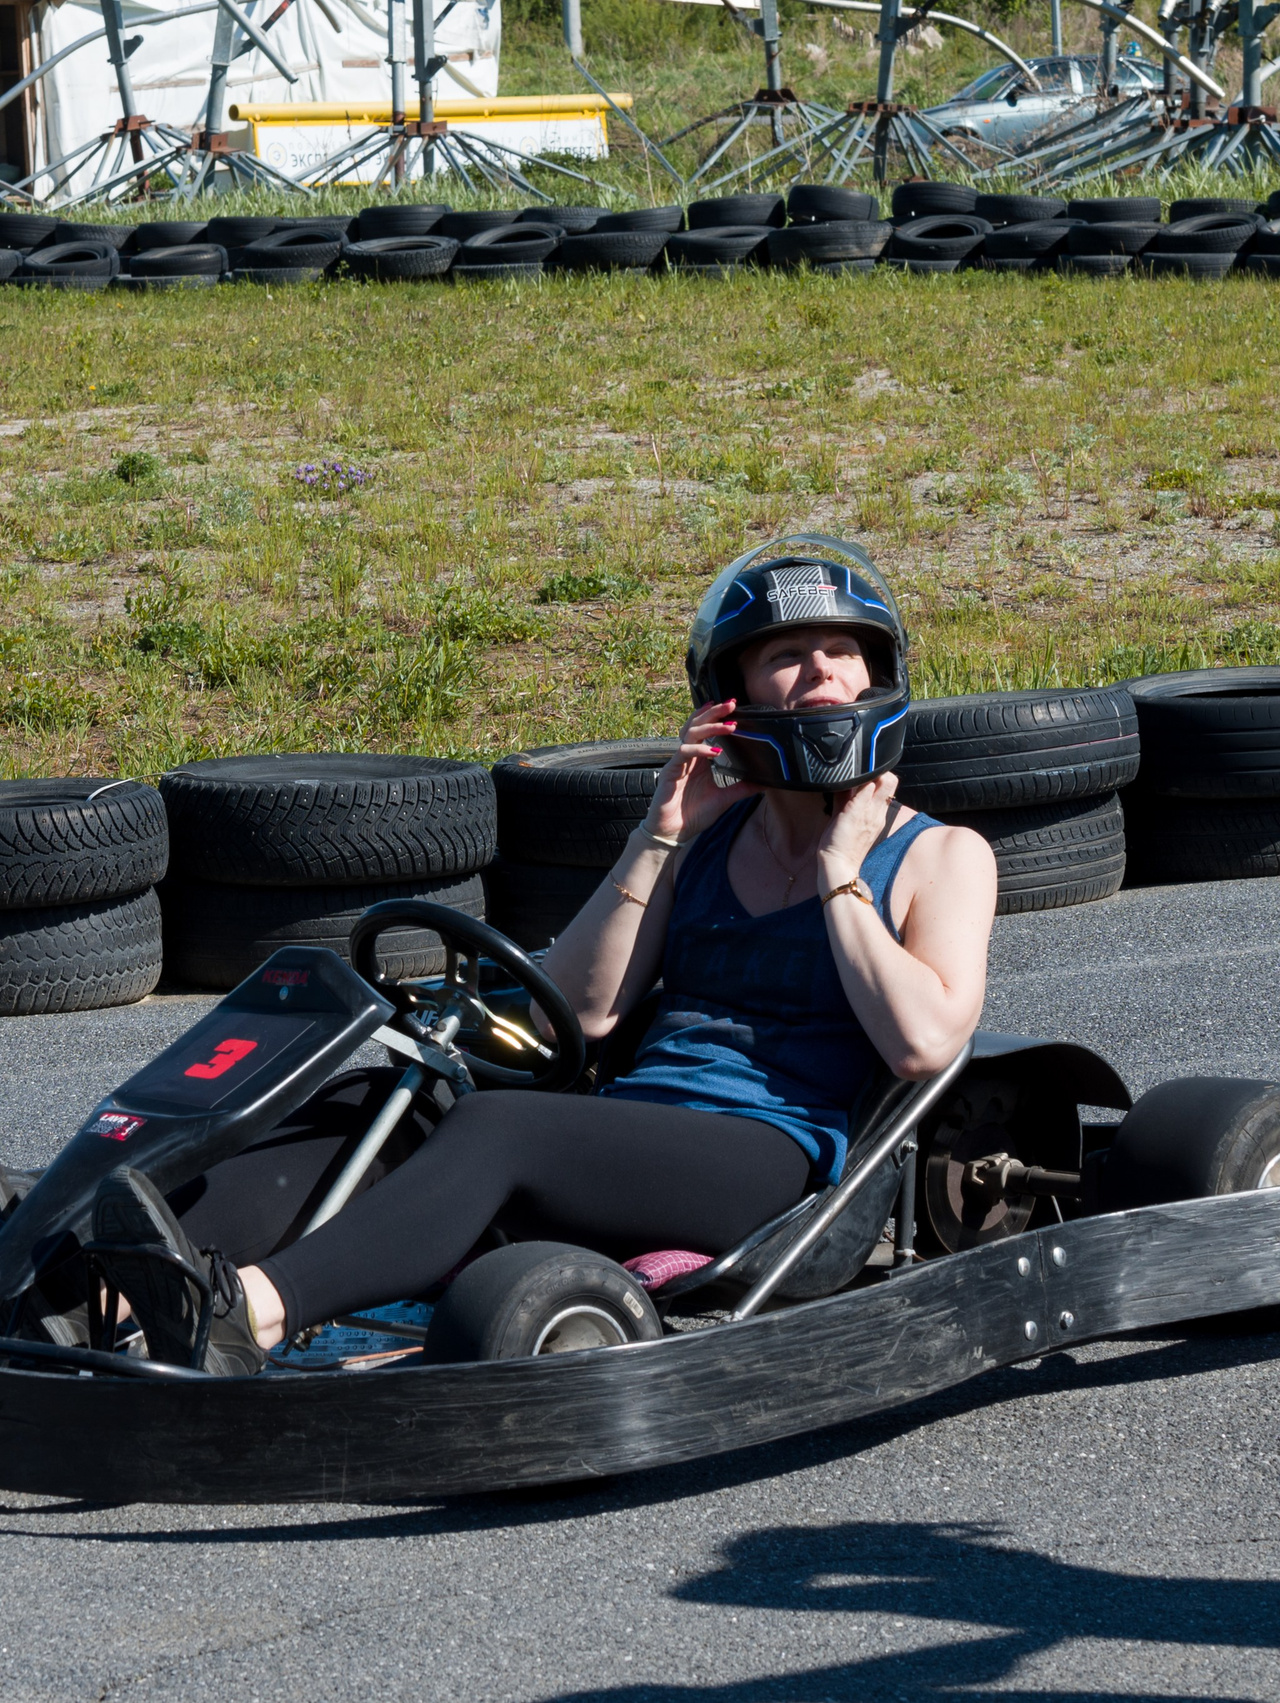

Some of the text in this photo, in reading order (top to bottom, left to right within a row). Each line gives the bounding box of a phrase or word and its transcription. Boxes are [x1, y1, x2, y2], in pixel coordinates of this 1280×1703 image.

[261, 970, 310, 984] KENDA
[184, 1038, 258, 1080] 3
[99, 1114, 129, 1124] LAVR
